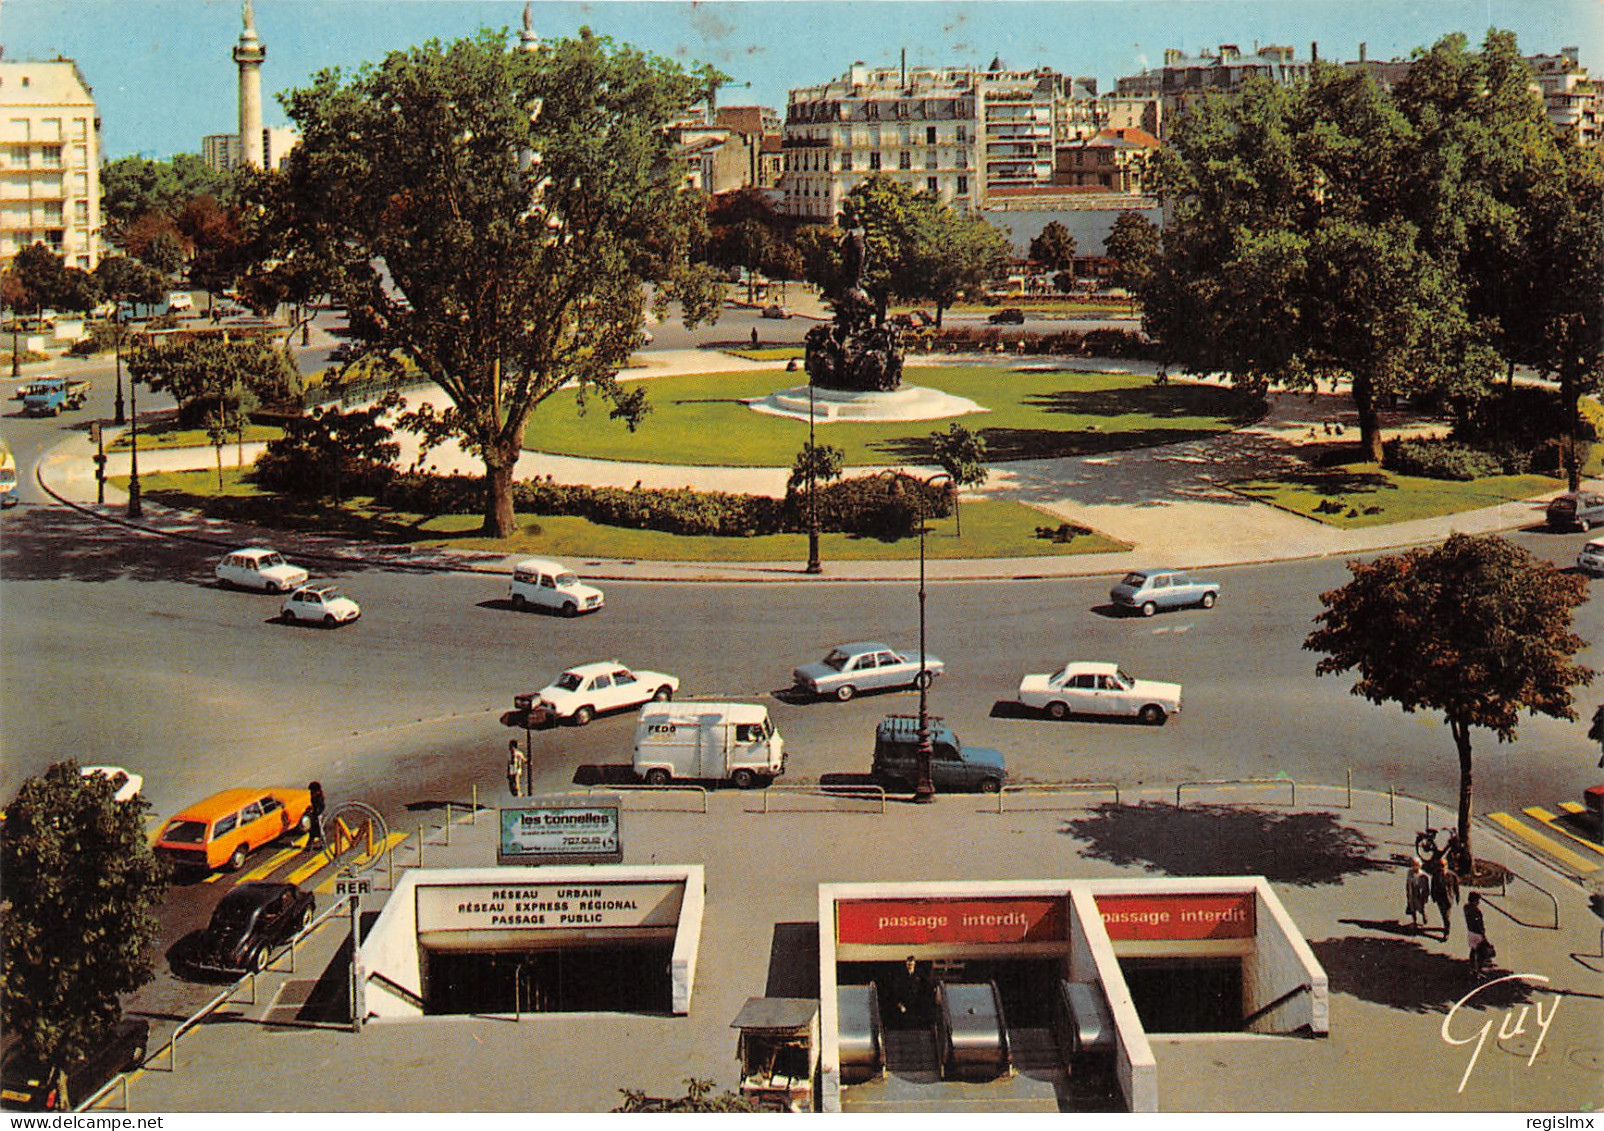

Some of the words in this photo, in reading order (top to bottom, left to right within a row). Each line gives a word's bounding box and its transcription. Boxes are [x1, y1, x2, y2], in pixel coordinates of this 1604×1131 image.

[521, 814, 541, 825] les
[544, 813, 609, 824] tonnelles
[334, 817, 373, 857] M
[336, 883, 368, 895] RER
[492, 889, 538, 900] RÉSEAU
[557, 889, 602, 898] URBAIN
[458, 903, 505, 913] RÉSEAU
[515, 901, 569, 912] EXPRESS
[579, 900, 638, 911] RÉGIONAL
[492, 915, 545, 925] PASSAGE
[560, 914, 603, 923] PUBLIC
[879, 915, 948, 929] passage
[963, 912, 1026, 926] interdit
[1101, 910, 1170, 925] passage
[1181, 908, 1246, 922] interdit
